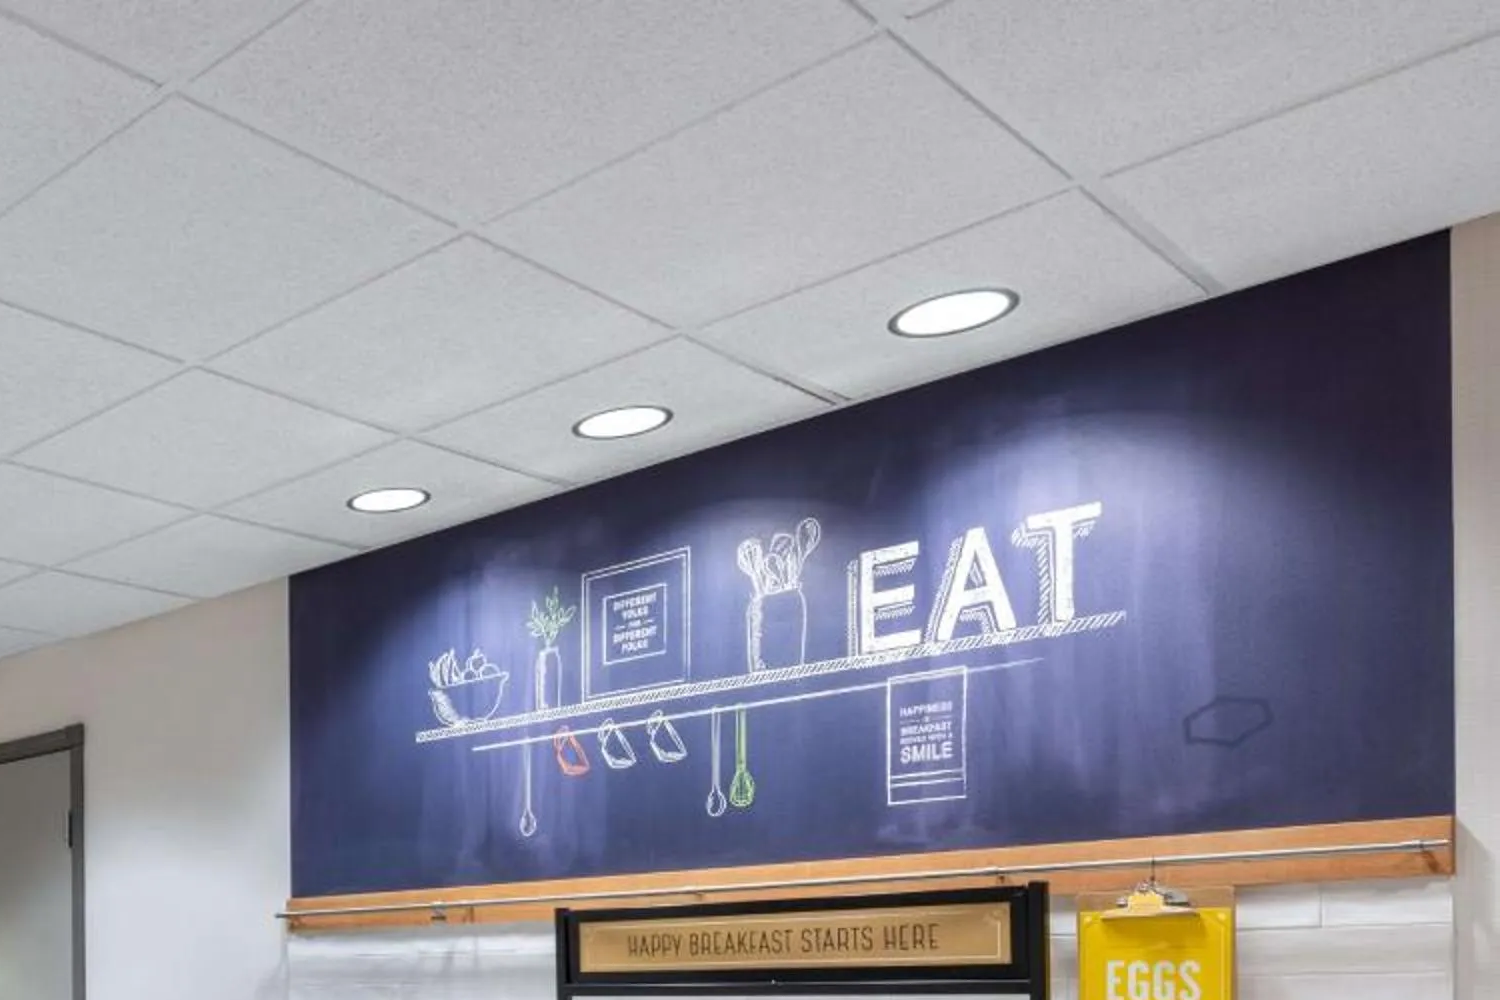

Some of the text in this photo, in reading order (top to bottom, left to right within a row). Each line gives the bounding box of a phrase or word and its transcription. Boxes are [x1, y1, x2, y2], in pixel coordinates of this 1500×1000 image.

[848, 501, 1102, 657] EAT
[612, 625, 657, 644] DIFFERENT
[900, 700, 953, 717] HAPPINESS
[900, 741, 954, 765] SMILE
[627, 922, 941, 957] HAPPY BREAKFAST STARTS HERE
